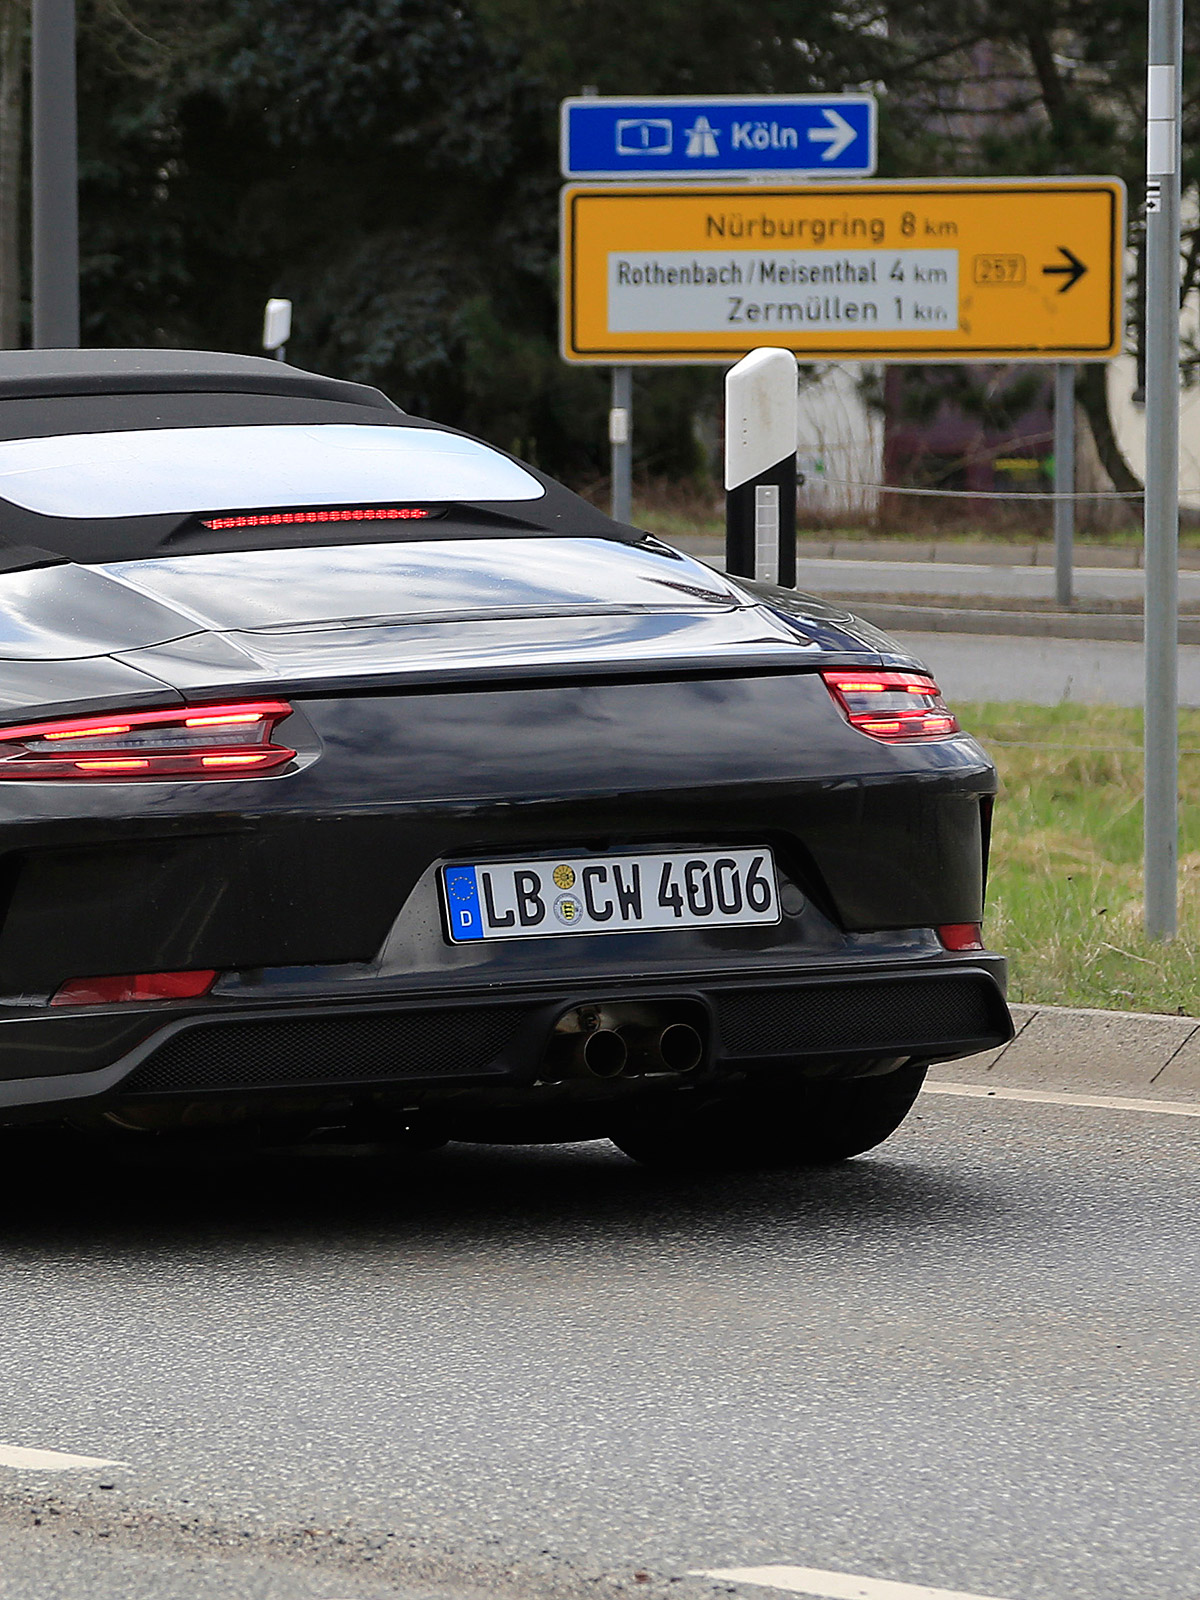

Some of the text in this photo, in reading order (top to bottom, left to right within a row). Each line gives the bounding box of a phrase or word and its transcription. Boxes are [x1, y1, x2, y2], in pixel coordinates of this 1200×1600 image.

[731, 120, 798, 150] Köln
[706, 211, 959, 244] Nürburgring 8 km
[890, 257, 905, 283] 4
[914, 263, 949, 284] km
[728, 295, 878, 323] Zermüllen
[893, 295, 903, 322] 1
[460, 910, 473, 927] D
[482, 870, 546, 928] LB
[582, 863, 643, 922] CW
[658, 856, 772, 918] 4006
